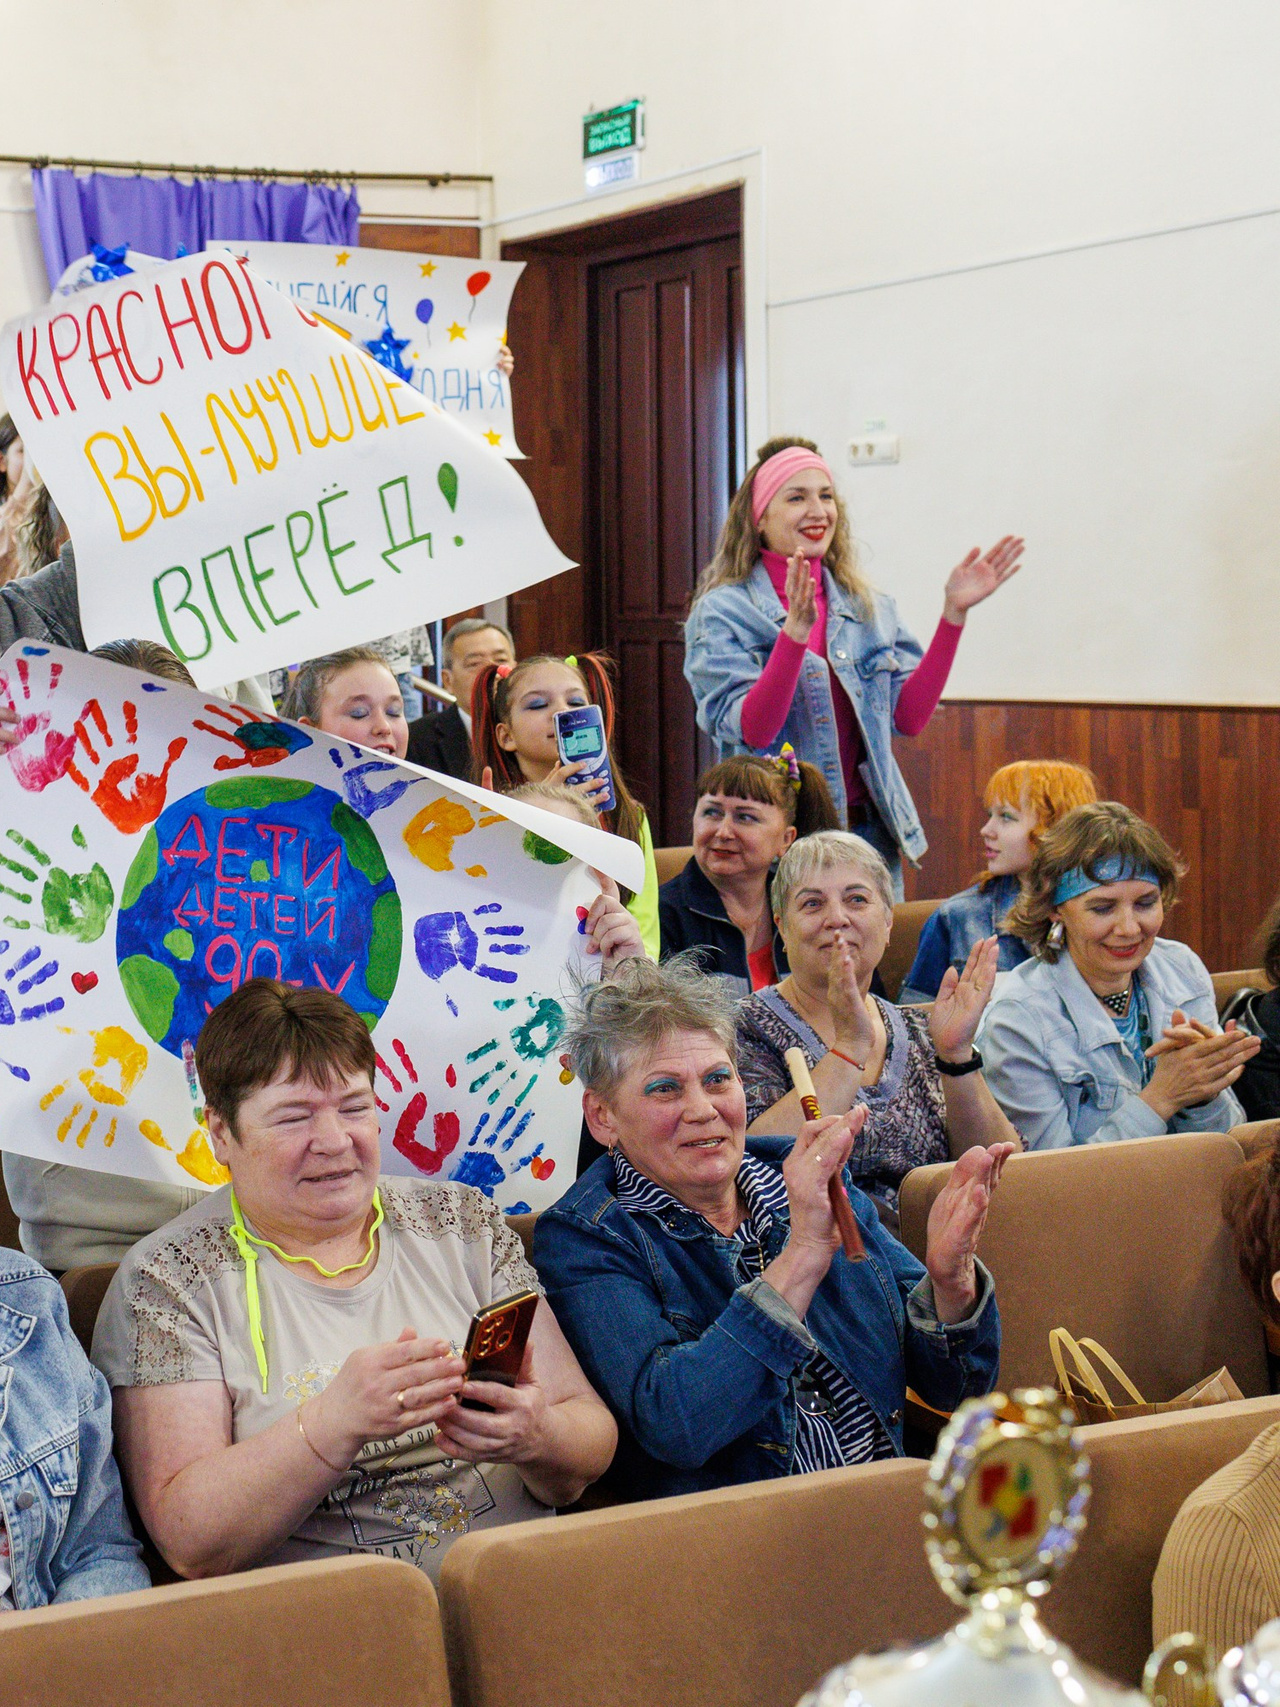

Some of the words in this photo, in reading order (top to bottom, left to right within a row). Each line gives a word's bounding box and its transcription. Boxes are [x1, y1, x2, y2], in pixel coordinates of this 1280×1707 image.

[588, 126, 632, 152] ВЫХОД
[417, 367, 505, 412] ОДНЯ
[161, 814, 342, 890] ДЕТИ
[172, 883, 336, 940] ДЕТЕЙ
[361, 1437, 400, 1458] MAKE
